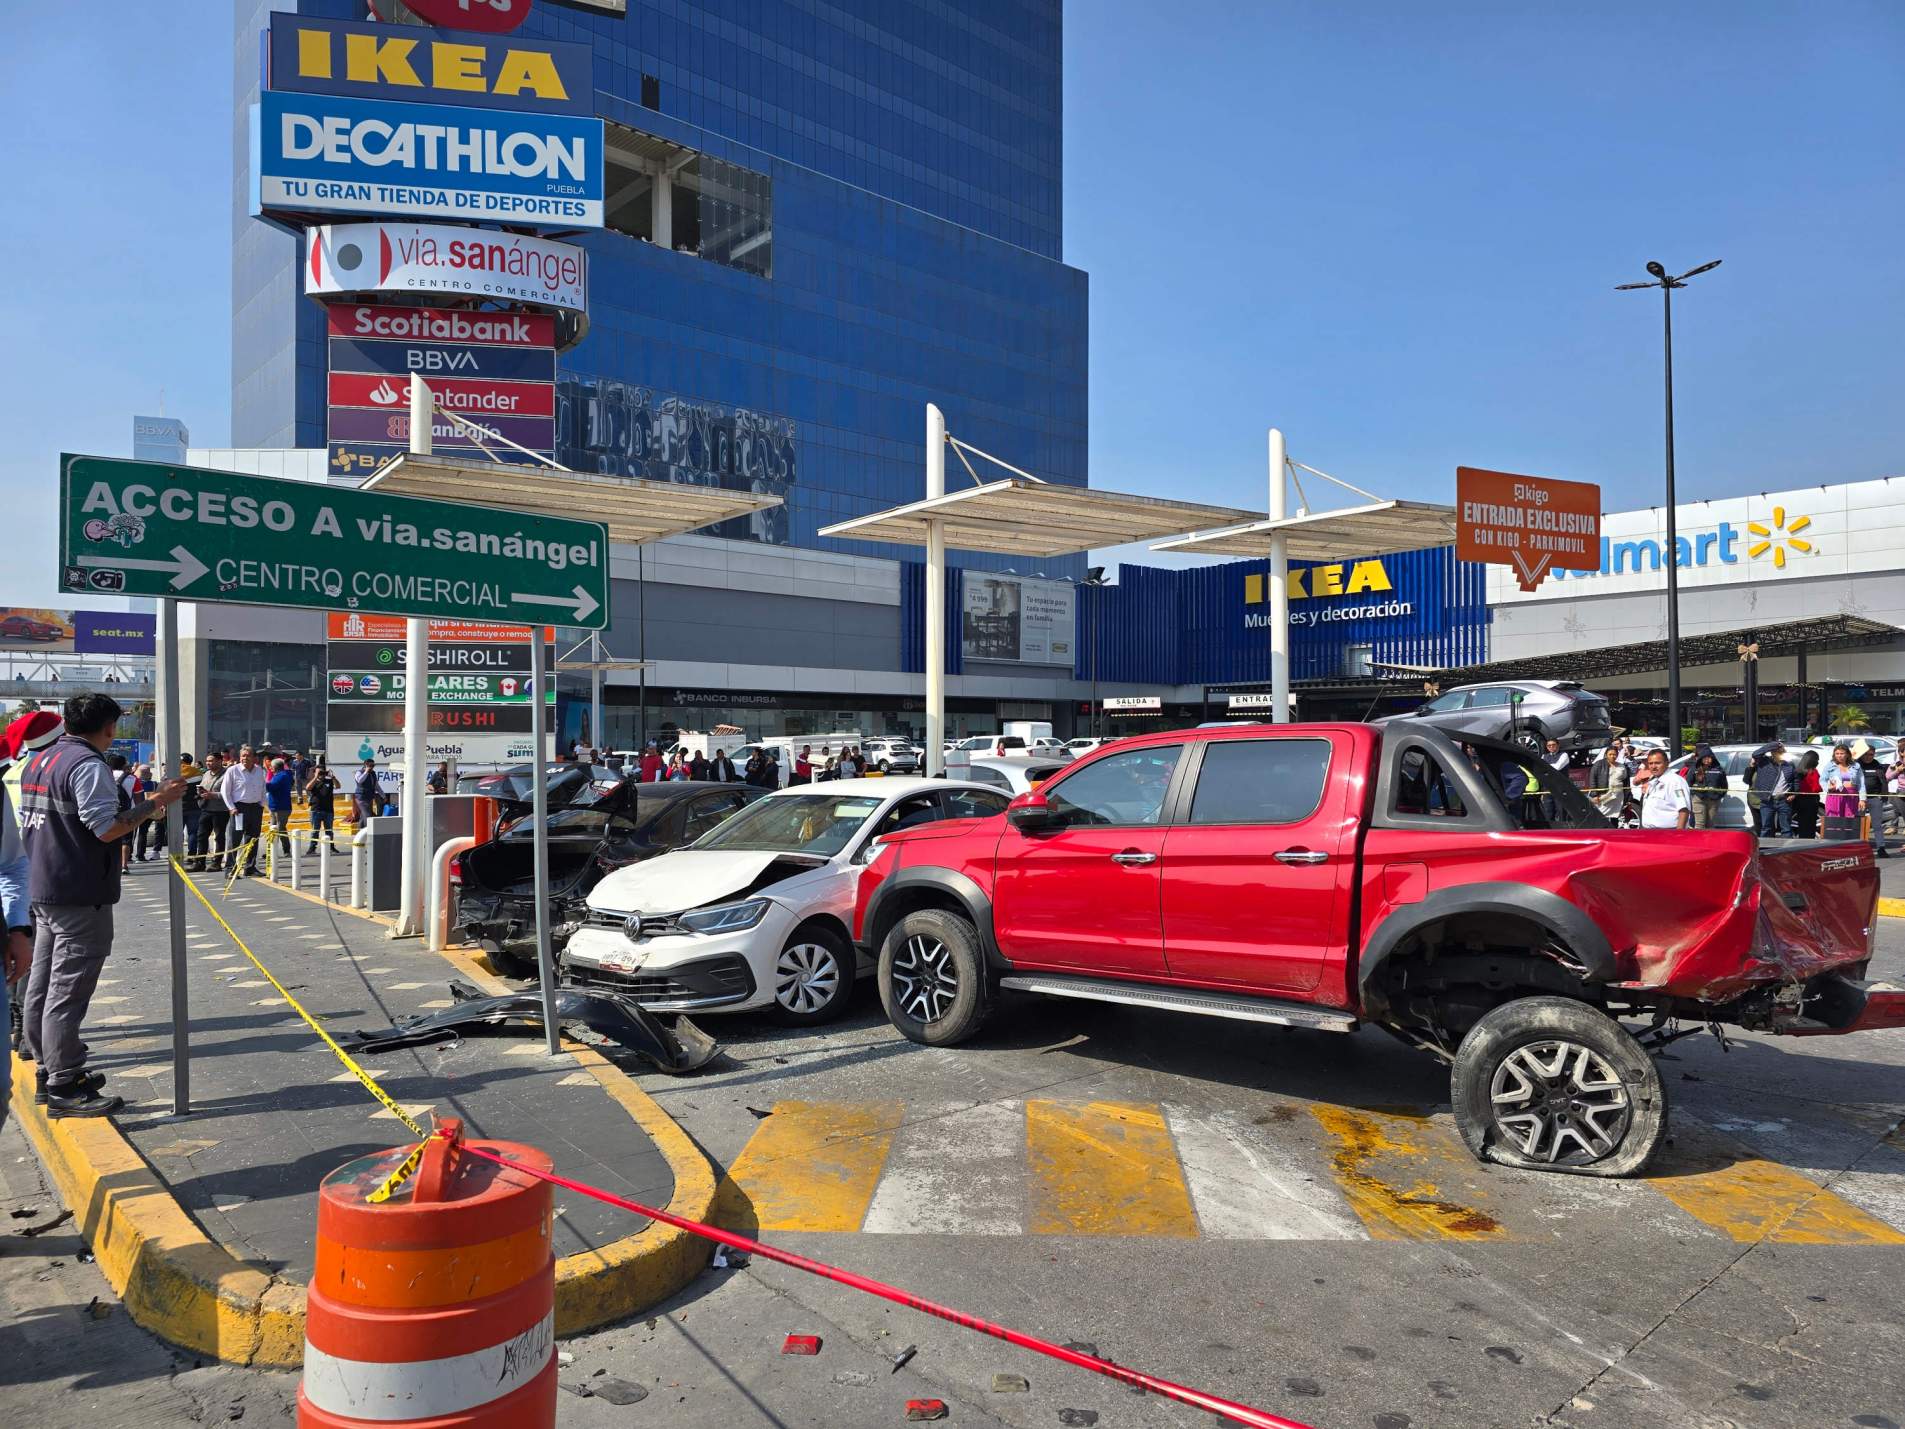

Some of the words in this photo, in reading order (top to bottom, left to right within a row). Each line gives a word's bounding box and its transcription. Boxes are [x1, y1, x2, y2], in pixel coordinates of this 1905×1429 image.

[298, 29, 569, 100] IKEA
[281, 112, 585, 181] DECATHLON
[282, 181, 308, 197] TU
[315, 183, 371, 201] GRAN
[377, 187, 448, 207] TIENDA
[455, 193, 481, 209] DE
[485, 195, 586, 217] DEPORTES
[547, 184, 585, 195] PUEBLA
[399, 229, 581, 290] via.sanángel
[407, 279, 472, 290] CENTRO
[484, 284, 577, 305] COMERCIAL
[355, 307, 531, 343] Scotiabank
[407, 350, 479, 370] BBVA
[402, 386, 519, 410] Sntander
[1526, 484, 1549, 505] kigo
[81, 481, 296, 532] ACCESO
[311, 506, 343, 539] A
[356, 513, 598, 571] via.sanángel
[1464, 501, 1524, 528] ENTRADA
[1527, 508, 1596, 535] EXCLUSIVA
[1474, 529, 1493, 544] CON
[1497, 531, 1520, 547] KIGO
[1530, 534, 1586, 553] PARKIMOVIL
[216, 558, 342, 594] CENTRO
[352, 570, 508, 609] COMERCIAL
[1245, 559, 1393, 604] IKEA
[1310, 612, 1319, 627] y
[1321, 600, 1411, 622] decoración
[92, 629, 144, 638] seat.mx
[397, 649, 509, 666] SSHIROLL
[431, 692, 493, 700] EXCHANGE
[687, 694, 728, 702] BANCO
[731, 695, 777, 703] INBURSA
[377, 744, 405, 758] Agua
